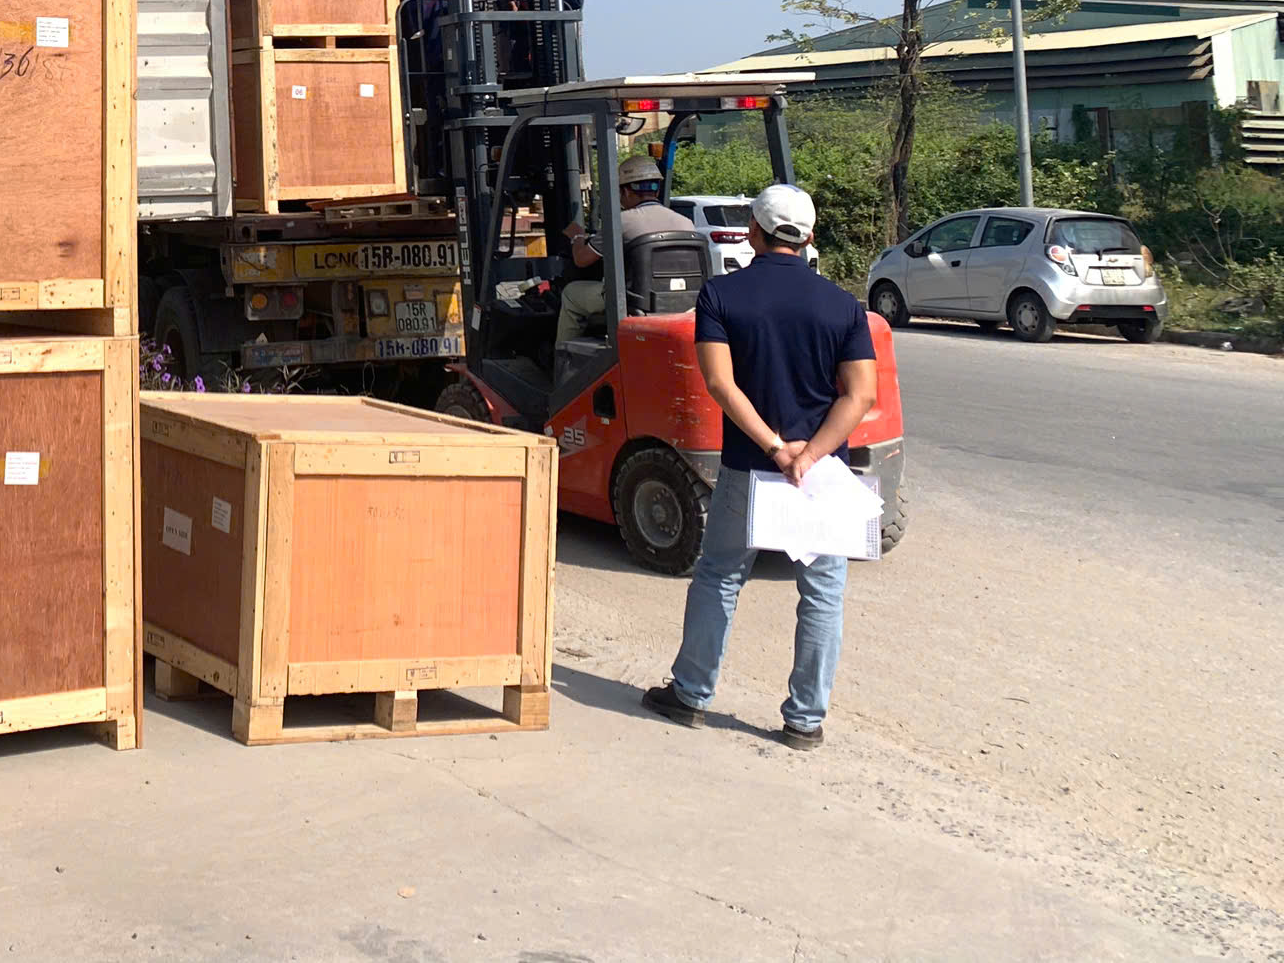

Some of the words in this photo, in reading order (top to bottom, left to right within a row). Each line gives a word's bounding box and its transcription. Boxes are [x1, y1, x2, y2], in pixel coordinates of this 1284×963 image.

[361, 244, 457, 269] 15R-080.91
[459, 225, 472, 286] HELI
[406, 302, 427, 316] 15R
[397, 317, 436, 333] 080.91
[563, 427, 585, 446] 35
